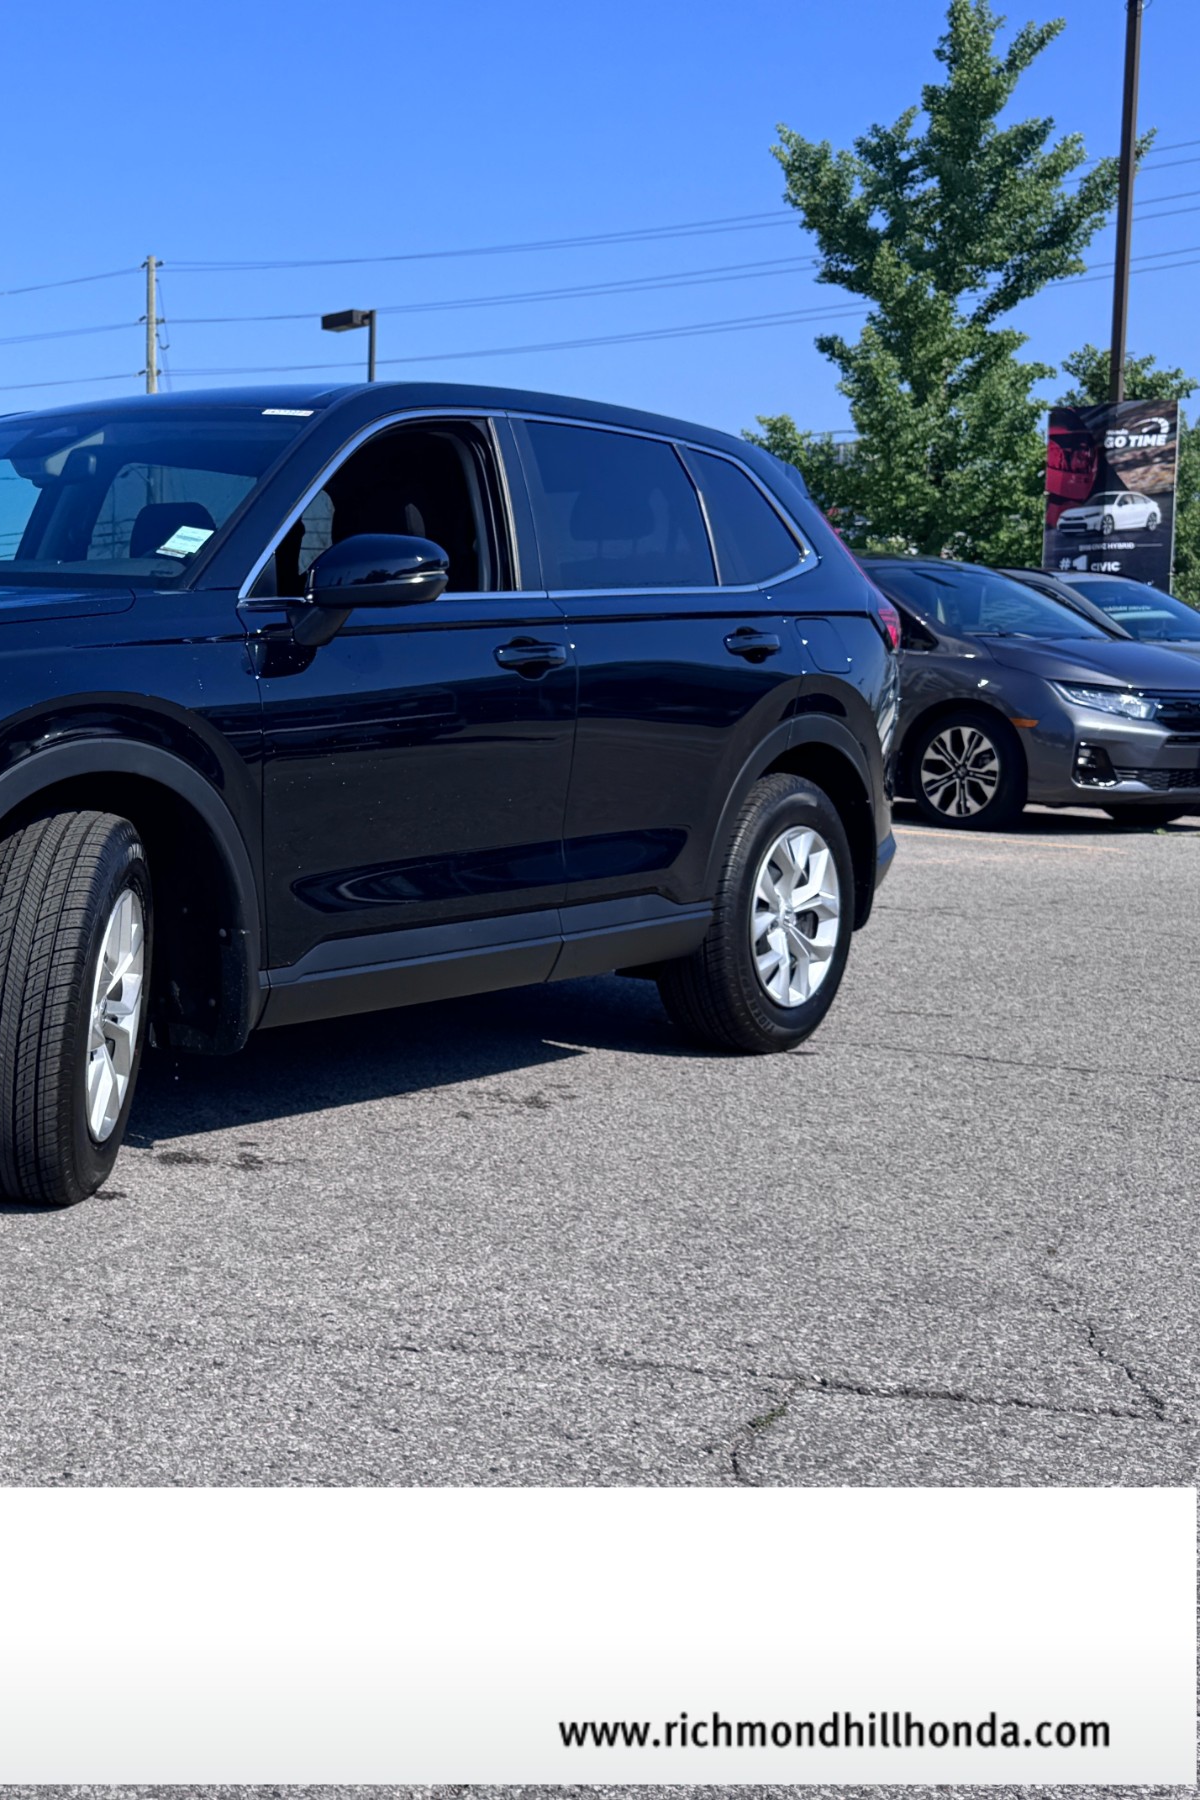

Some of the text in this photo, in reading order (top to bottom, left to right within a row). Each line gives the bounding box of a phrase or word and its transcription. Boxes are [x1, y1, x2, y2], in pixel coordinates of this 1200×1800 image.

[1104, 433, 1168, 449] GO TIME
[1090, 561, 1121, 572] CIVIC
